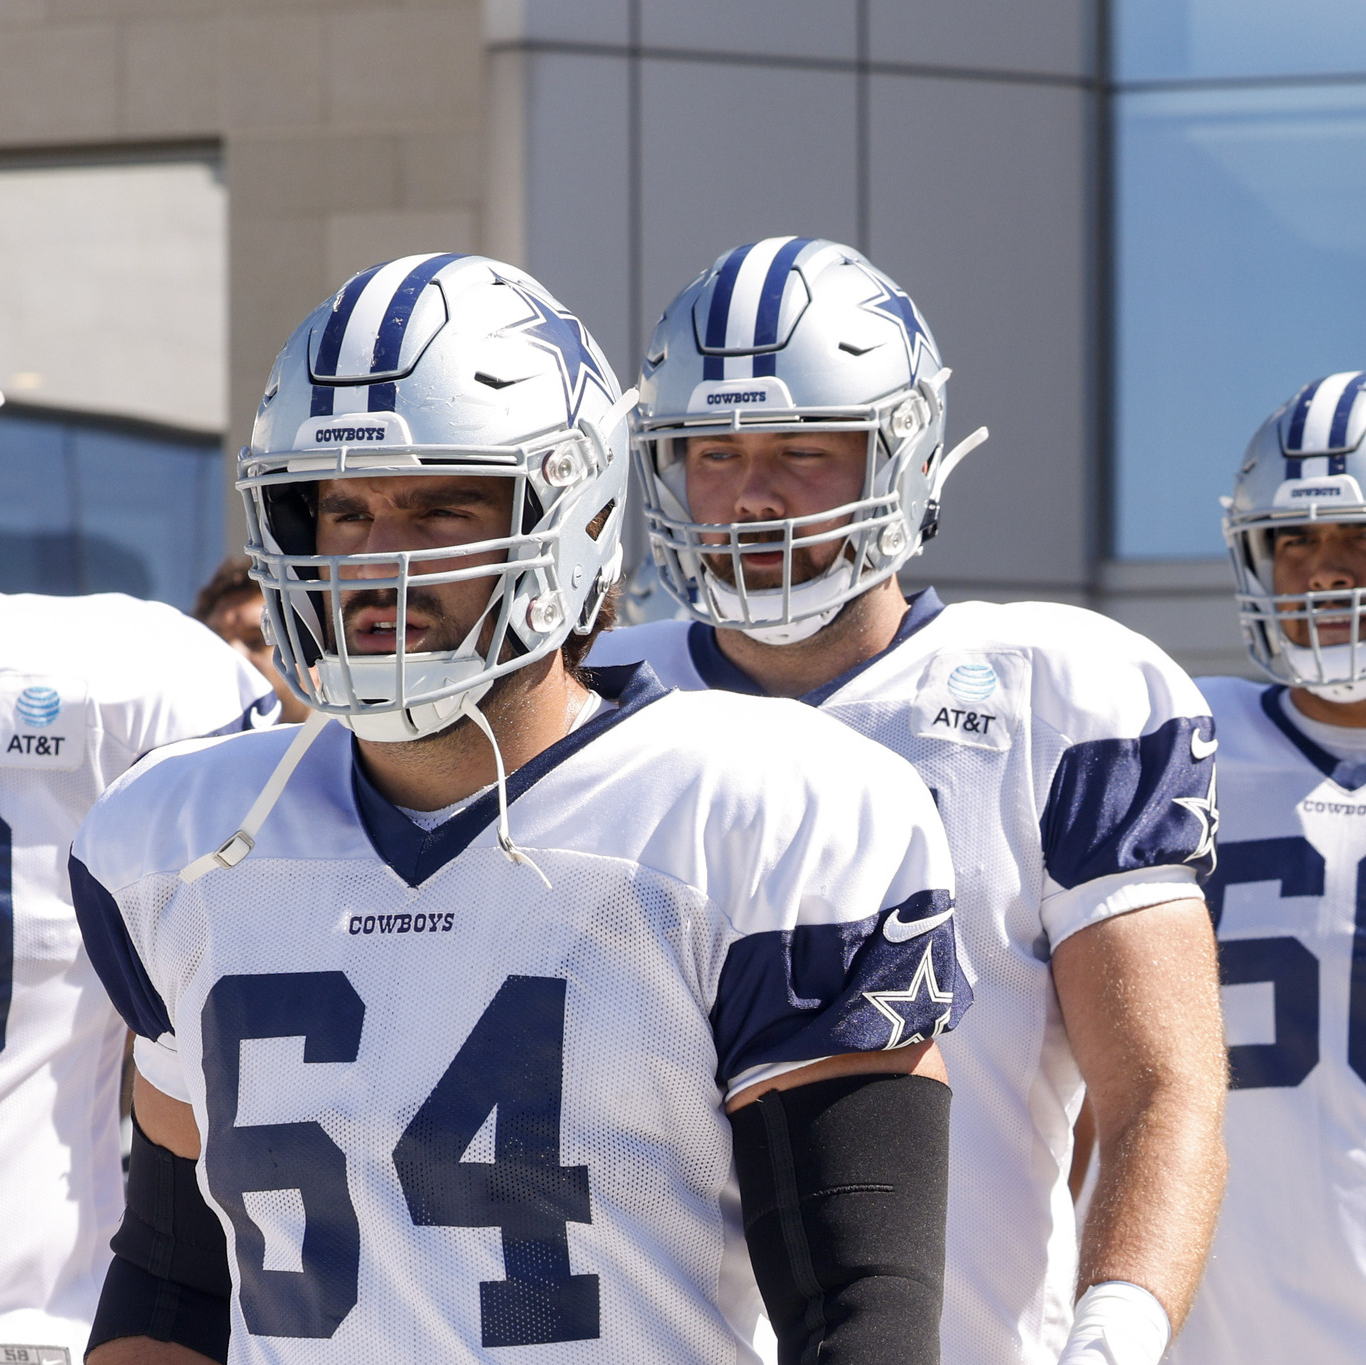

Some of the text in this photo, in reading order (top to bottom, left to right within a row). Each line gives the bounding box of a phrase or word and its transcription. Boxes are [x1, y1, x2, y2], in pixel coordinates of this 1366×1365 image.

[706, 391, 766, 405] COWBOYS
[316, 428, 385, 442] COWBOYS
[932, 707, 996, 735] AT&T
[6, 734, 65, 755] AT&T
[349, 913, 454, 935] COWBOYS
[201, 971, 602, 1348] 64
